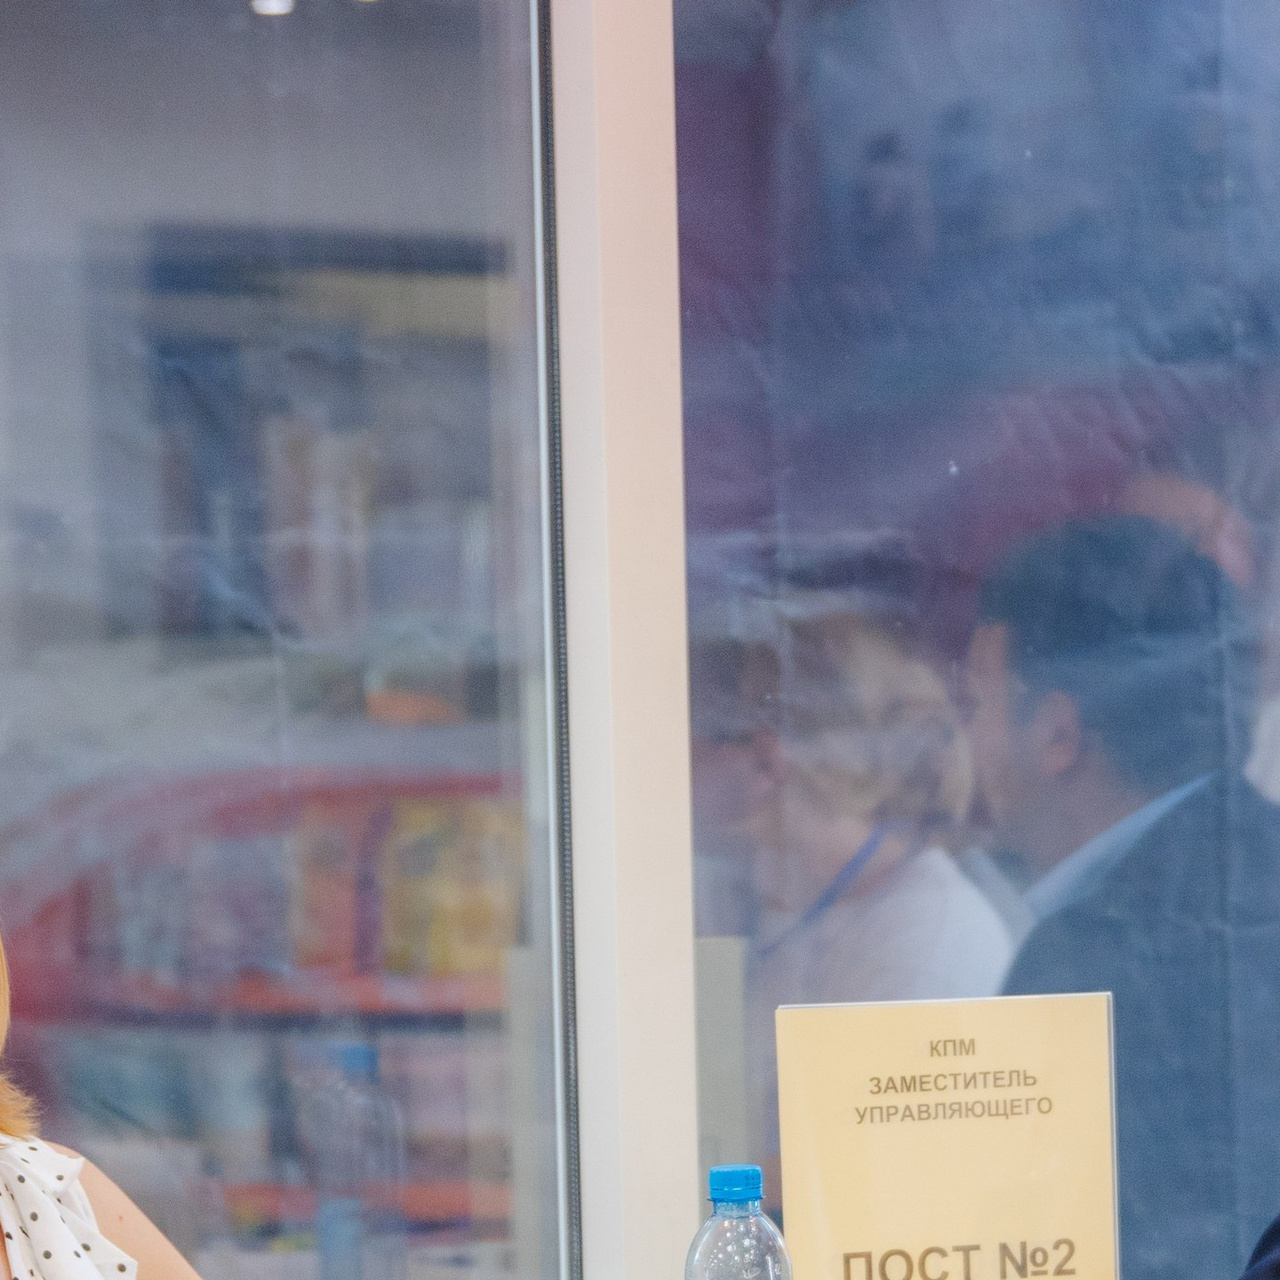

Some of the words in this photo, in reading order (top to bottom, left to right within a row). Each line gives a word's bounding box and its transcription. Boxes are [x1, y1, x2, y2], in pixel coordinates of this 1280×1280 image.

[929, 1038, 976, 1057] КПМ
[868, 1069, 1038, 1095] ЗАМЕСТИТЕЛЬ
[855, 1096, 1053, 1125] УПРАВЛЯЮЩЕГО
[999, 1238, 1076, 1280] №2
